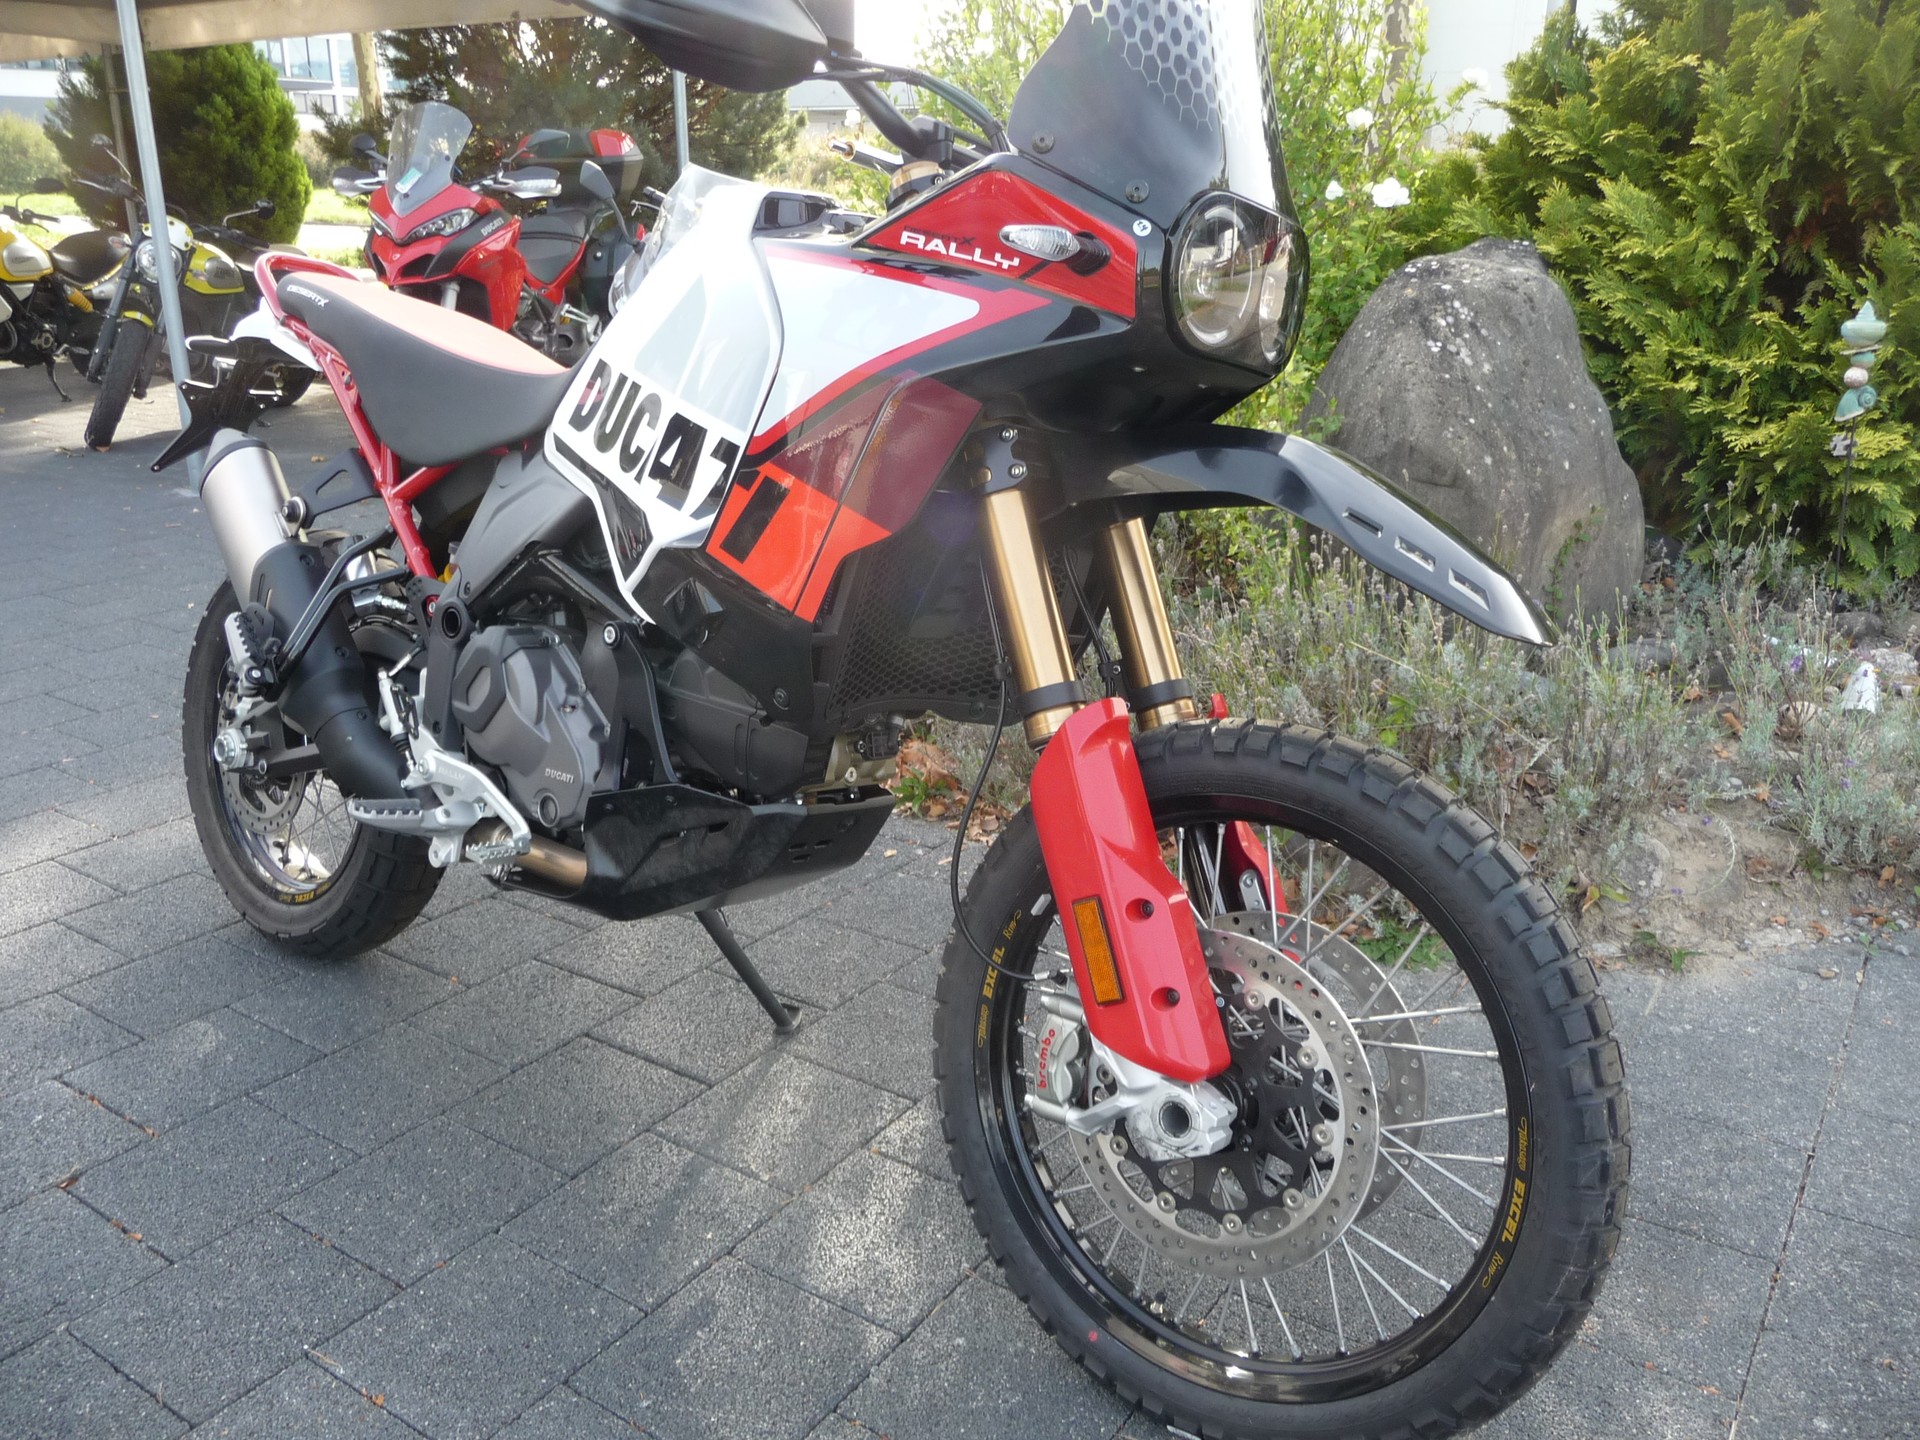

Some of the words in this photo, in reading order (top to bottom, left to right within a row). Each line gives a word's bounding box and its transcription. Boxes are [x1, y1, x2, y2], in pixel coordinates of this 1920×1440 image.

[480, 217, 505, 237] DUCATI
[899, 230, 1020, 270] RALLY
[544, 767, 575, 784] DUCATI
[982, 946, 1006, 1000] EXCEL
[1037, 1028, 1056, 1089] brembo
[1501, 1177, 1527, 1244] EXCEL
